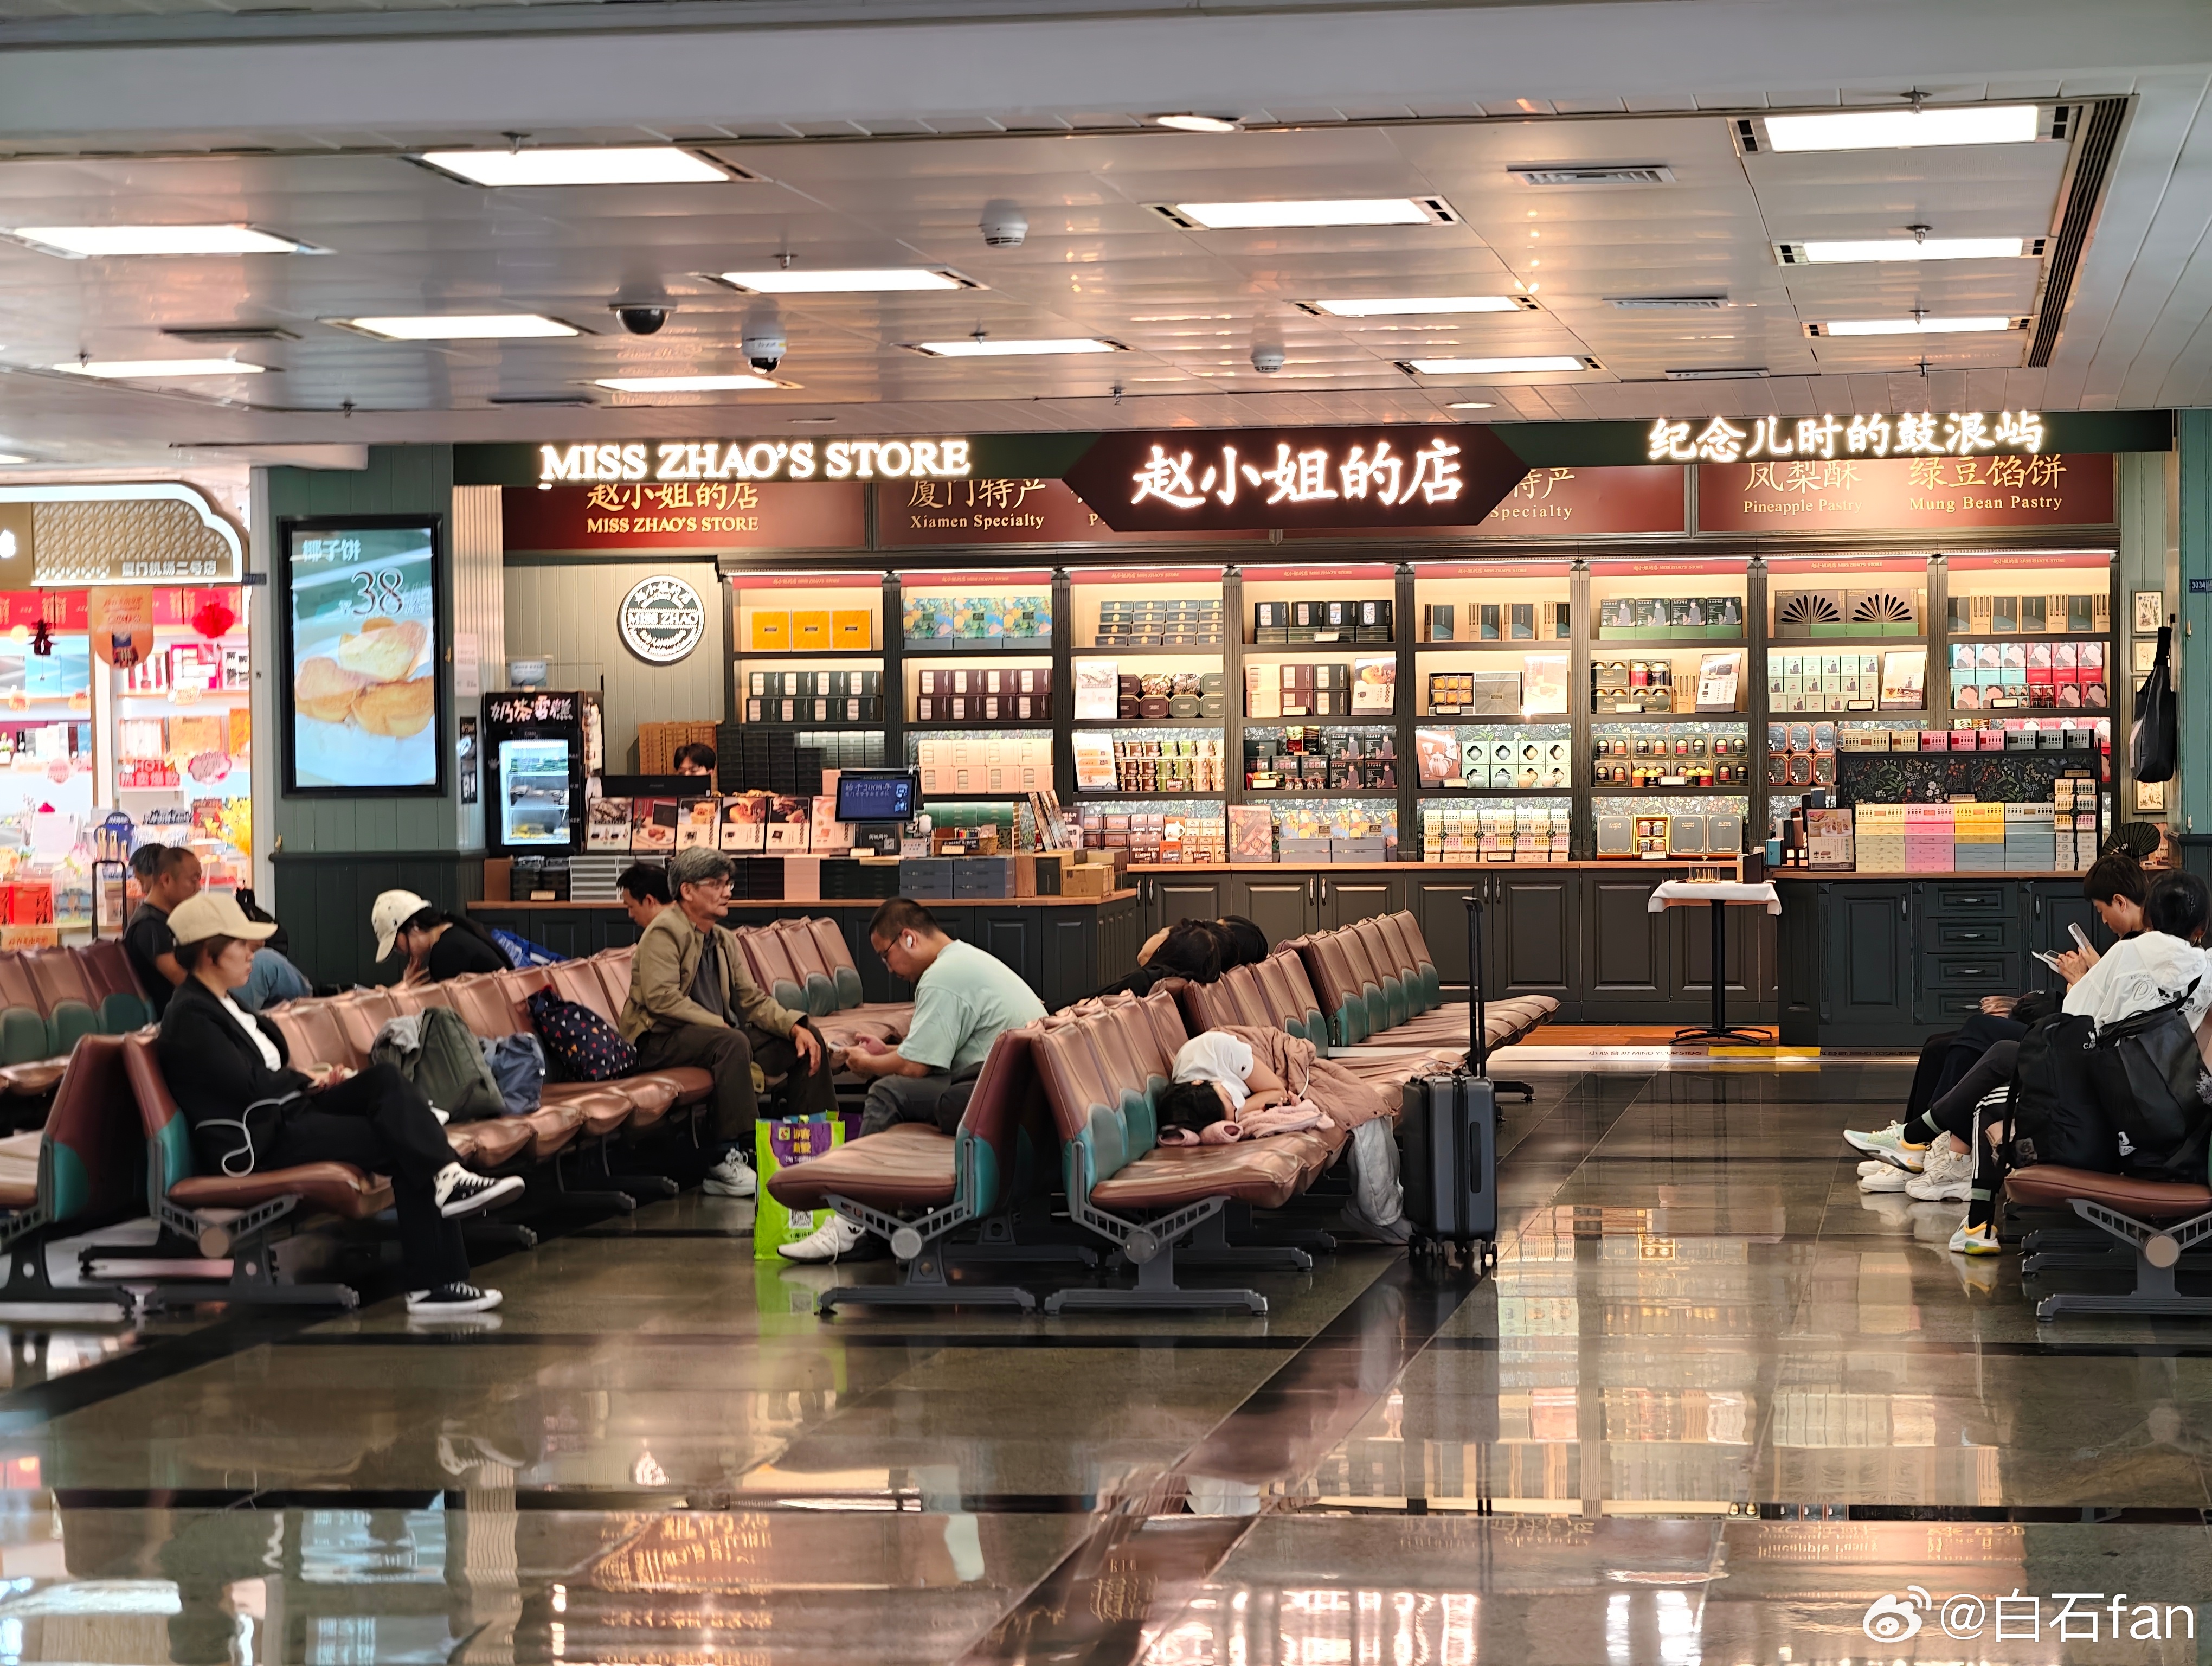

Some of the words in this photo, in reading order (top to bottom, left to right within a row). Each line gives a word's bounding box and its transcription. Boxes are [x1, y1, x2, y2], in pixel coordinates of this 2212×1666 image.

[1649, 411, 2044, 463] 纪念儿时的鼓浪屿
[539, 445, 648, 480] MISS
[657, 443, 814, 479] ZHAO'S
[826, 442, 970, 477] STORE
[1908, 454, 2067, 491] 绿豆馅饼
[1131, 440, 1464, 507] 赵小姐的店
[1744, 459, 1863, 494] 凤梨酥
[586, 482, 758, 511] 赵小姐的店
[906, 478, 1046, 509] 厦门特产
[1909, 497, 1956, 512] Mung
[1962, 496, 2003, 509] Bean
[2010, 496, 2062, 510] Pastry
[1490, 504, 1573, 521] Specialty
[1744, 499, 1813, 515] Pineapple
[1818, 499, 1862, 514] Pastry
[587, 517, 629, 533] MISS
[633, 517, 697, 533] ZHAO'S
[701, 516, 758, 532] STORE
[910, 515, 967, 528] Xiamen
[974, 513, 1044, 529] Specialty
[2192, 581, 2205, 589] 3034
[627, 613, 658, 625] MISS
[660, 612, 699, 625] ZHAO
